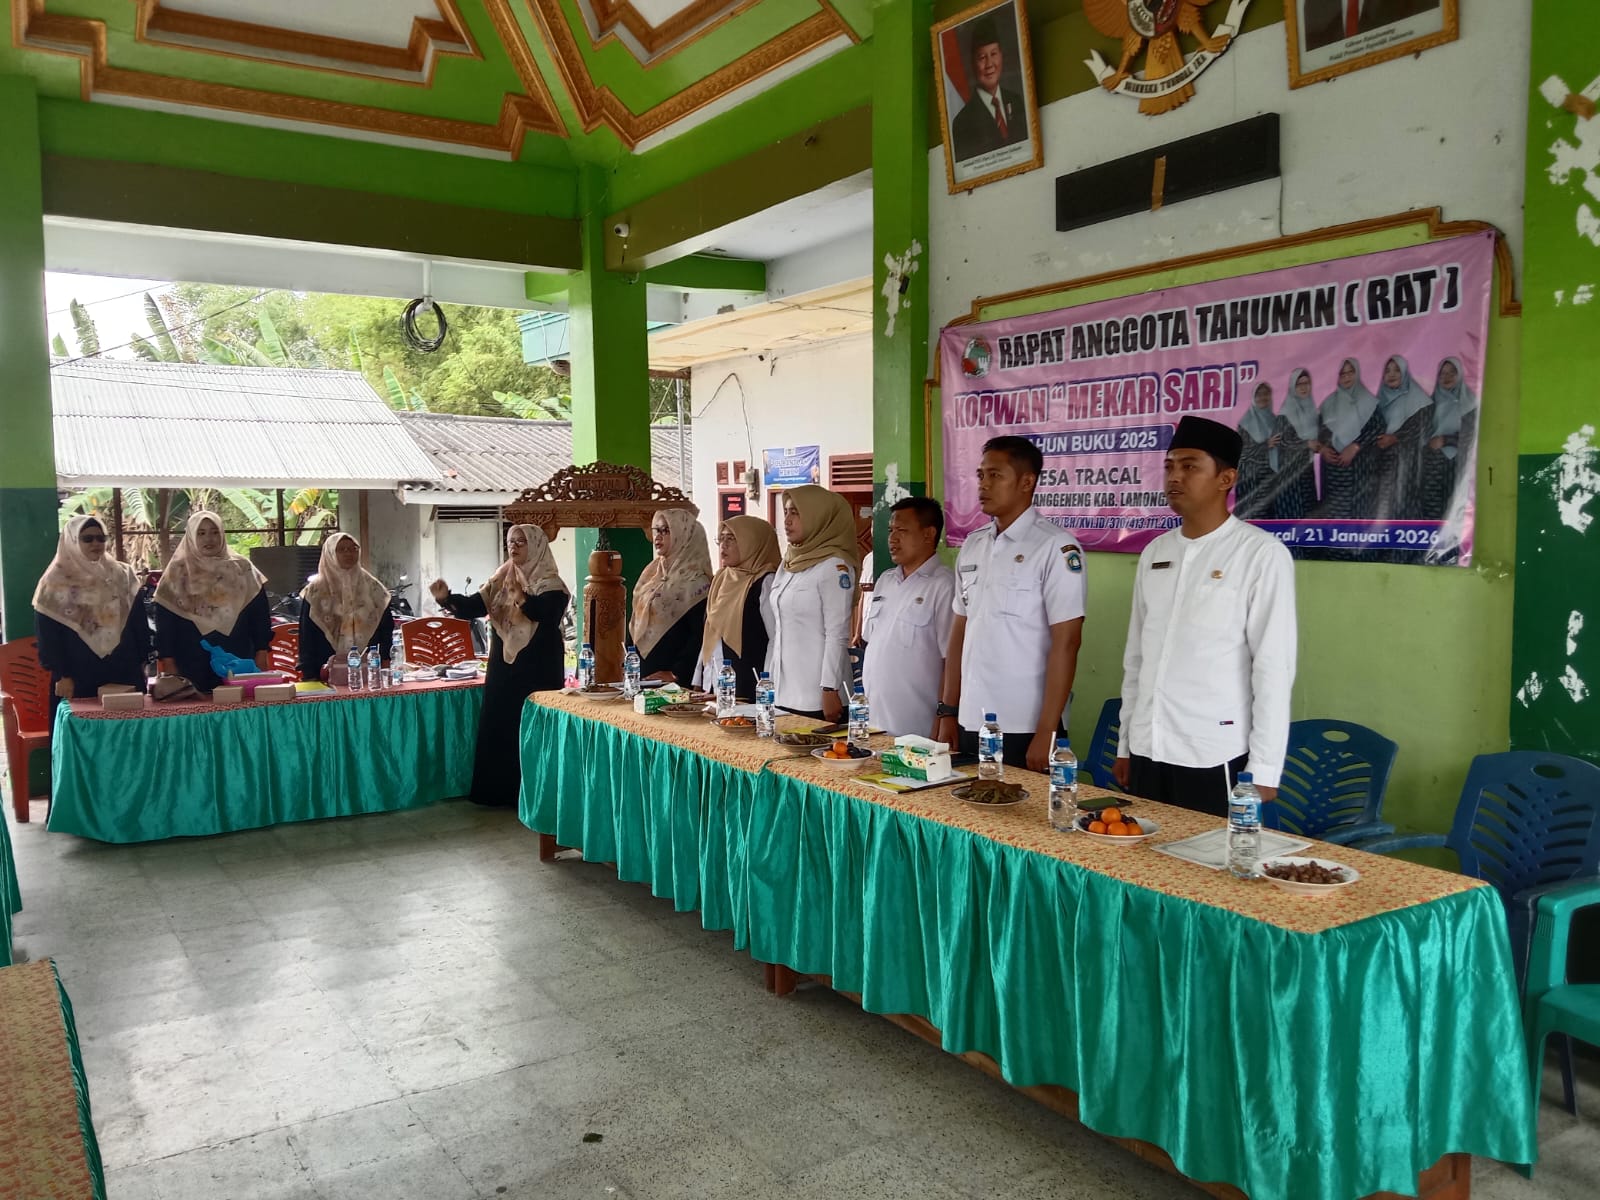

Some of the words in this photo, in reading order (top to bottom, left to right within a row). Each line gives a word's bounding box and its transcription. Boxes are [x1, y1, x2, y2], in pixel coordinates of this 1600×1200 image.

[999, 328, 1066, 369] RAPAT
[1070, 309, 1190, 361] ANGGOTA
[1195, 285, 1336, 344] TAHUNAN
[954, 390, 1048, 429] KOPWAN
[1029, 436, 1068, 453] HUN
[1071, 433, 1115, 452] BUKU
[1119, 430, 1158, 449] 2025
[1039, 469, 1069, 487] ESA
[1075, 466, 1142, 486] TRACAL
[1033, 492, 1091, 508] ANGGENENG
[1093, 492, 1118, 508] KAB.
[1120, 491, 1170, 507] LAMONG
[1272, 527, 1300, 543] cal,
[1304, 528, 1324, 542] 21
[1329, 528, 1390, 543] Januari
[1395, 529, 1440, 545] 2026
